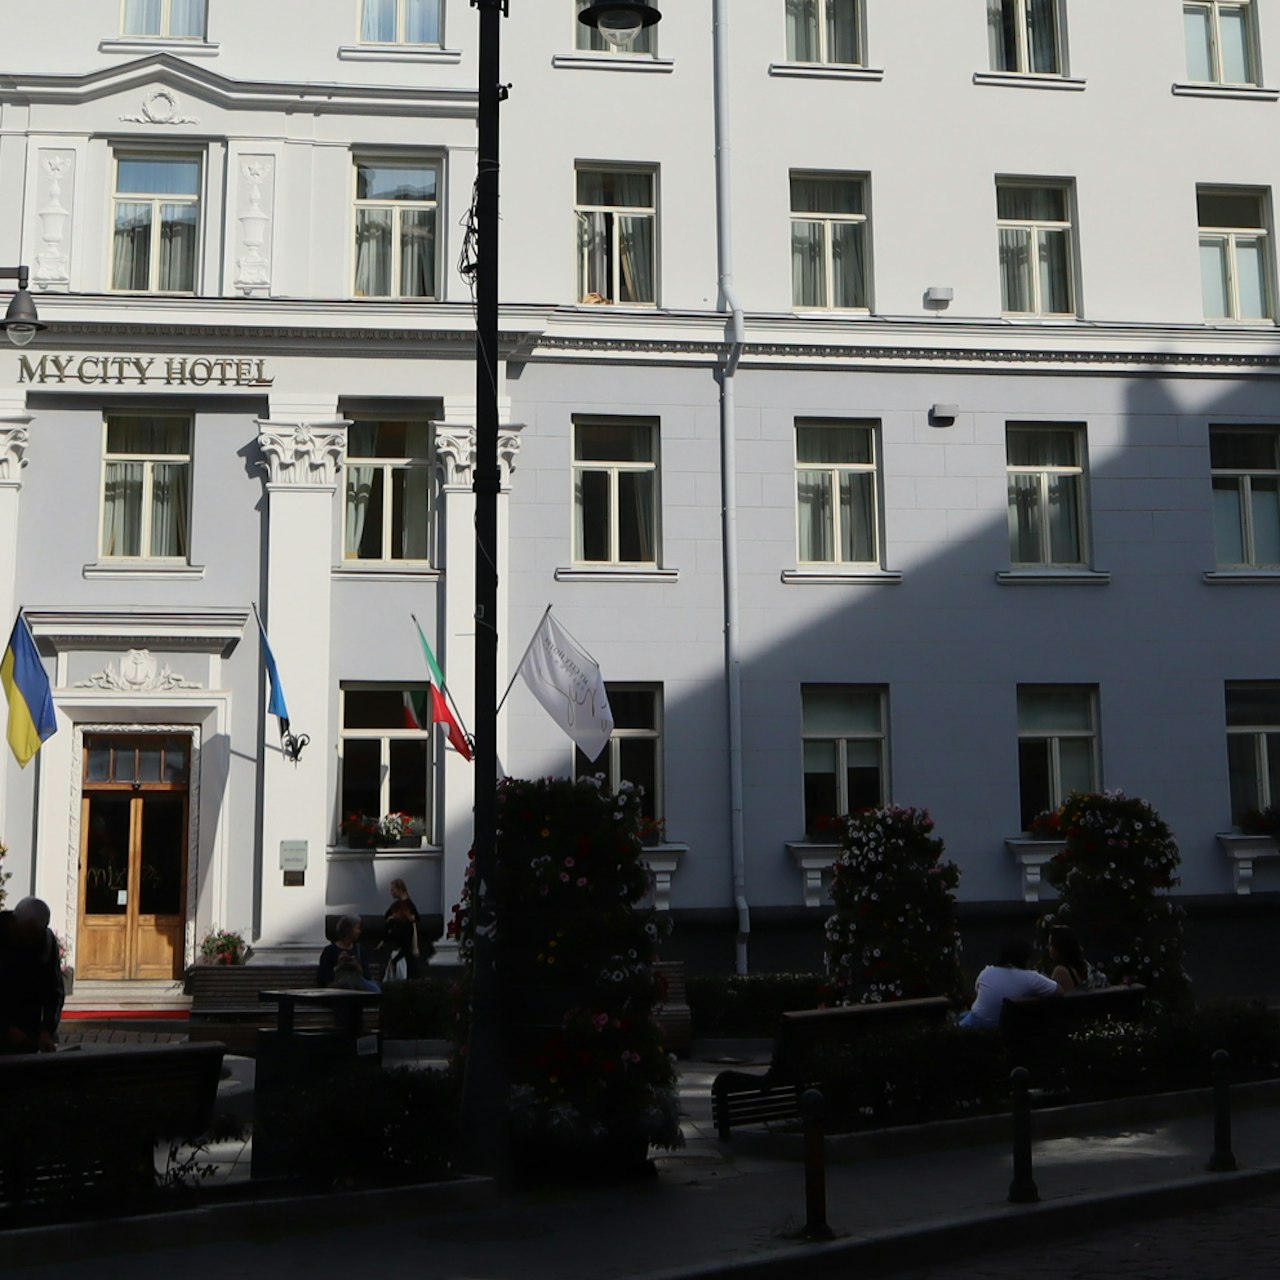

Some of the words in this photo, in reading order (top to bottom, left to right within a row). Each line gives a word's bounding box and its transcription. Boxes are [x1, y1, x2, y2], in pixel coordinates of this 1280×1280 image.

[17, 354, 73, 384] MY
[77, 355, 156, 385] CITY
[164, 357, 274, 387] HOTEL
